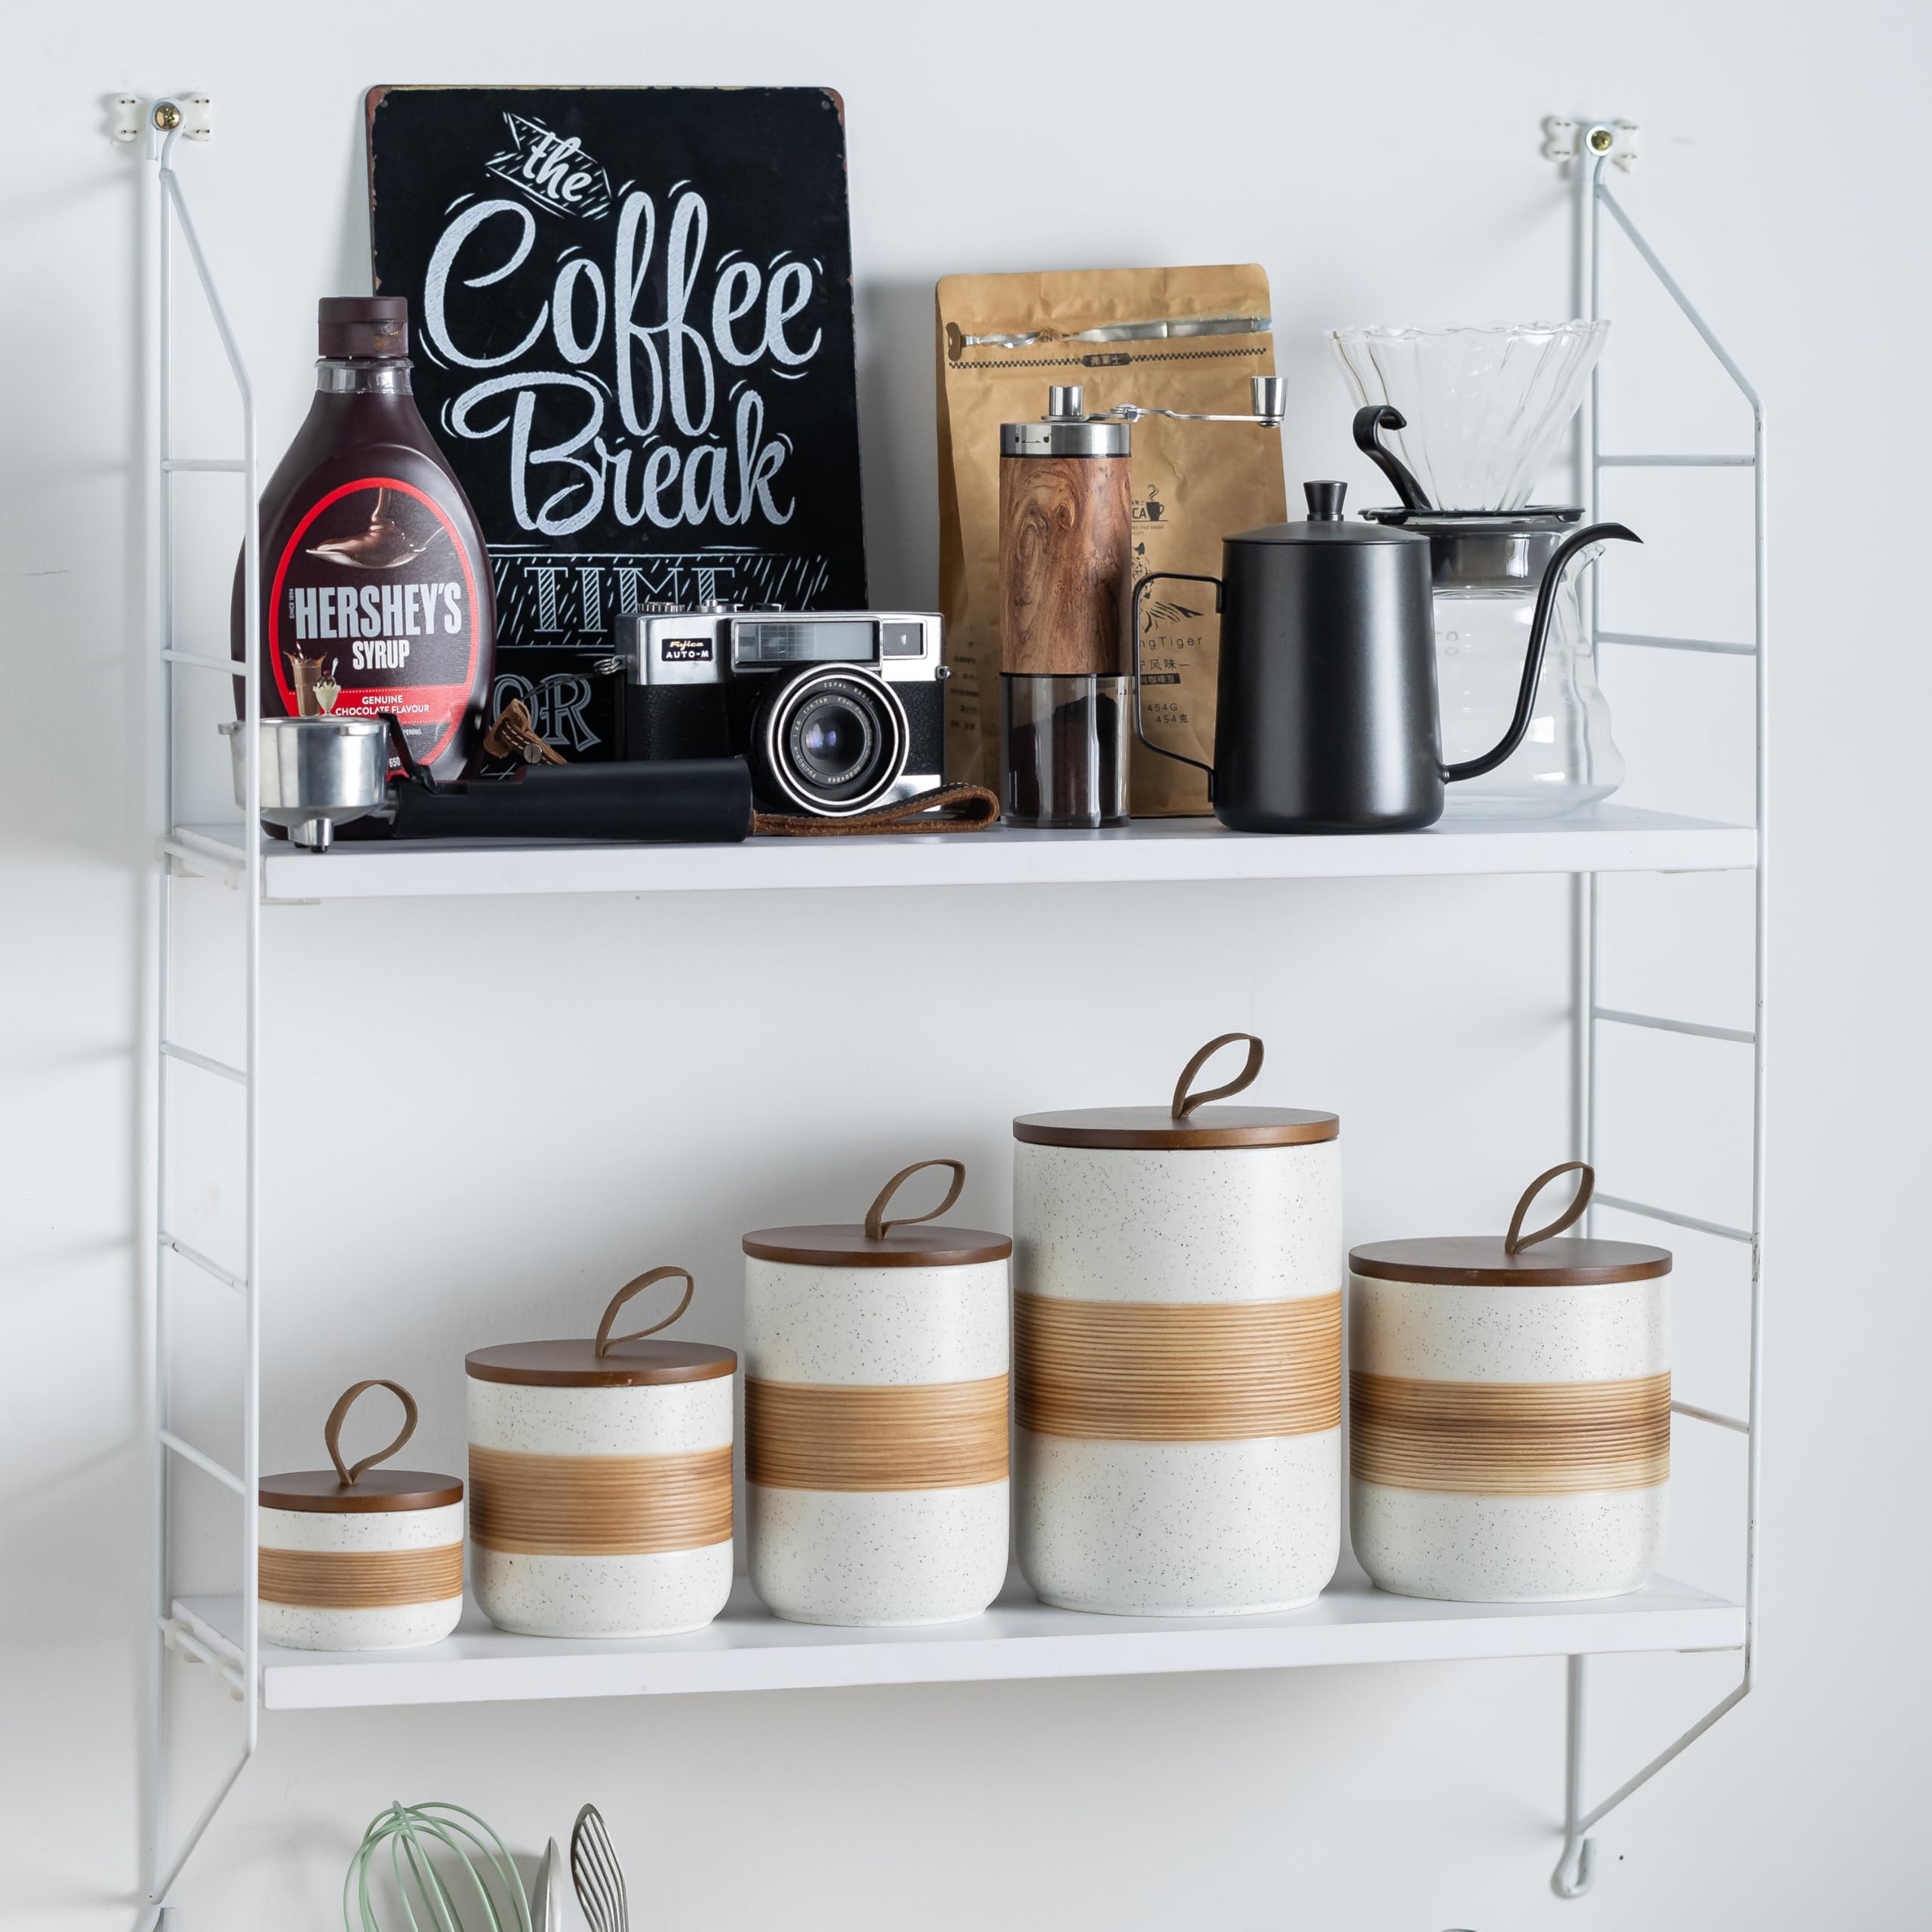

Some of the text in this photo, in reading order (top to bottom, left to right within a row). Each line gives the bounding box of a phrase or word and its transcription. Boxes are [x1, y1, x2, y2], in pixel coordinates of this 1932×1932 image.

[522, 132, 592, 202] the
[424, 191, 822, 436] Coffee
[452, 371, 795, 536] Break
[1132, 507, 1147, 519] CA
[294, 582, 463, 640] HERSHEY'S
[669, 640, 705, 651] Fujica
[1140, 637, 1203, 651] ngTiger
[352, 639, 411, 670] SYRUP
[666, 650, 709, 659] AUTO-M
[361, 695, 404, 705] GENUINE
[335, 704, 429, 716] CHOCOLATE FLAVOUR
[1147, 703, 1178, 712] 454G
[1155, 712, 1189, 724] 454克
[389, 756, 401, 768] 650
